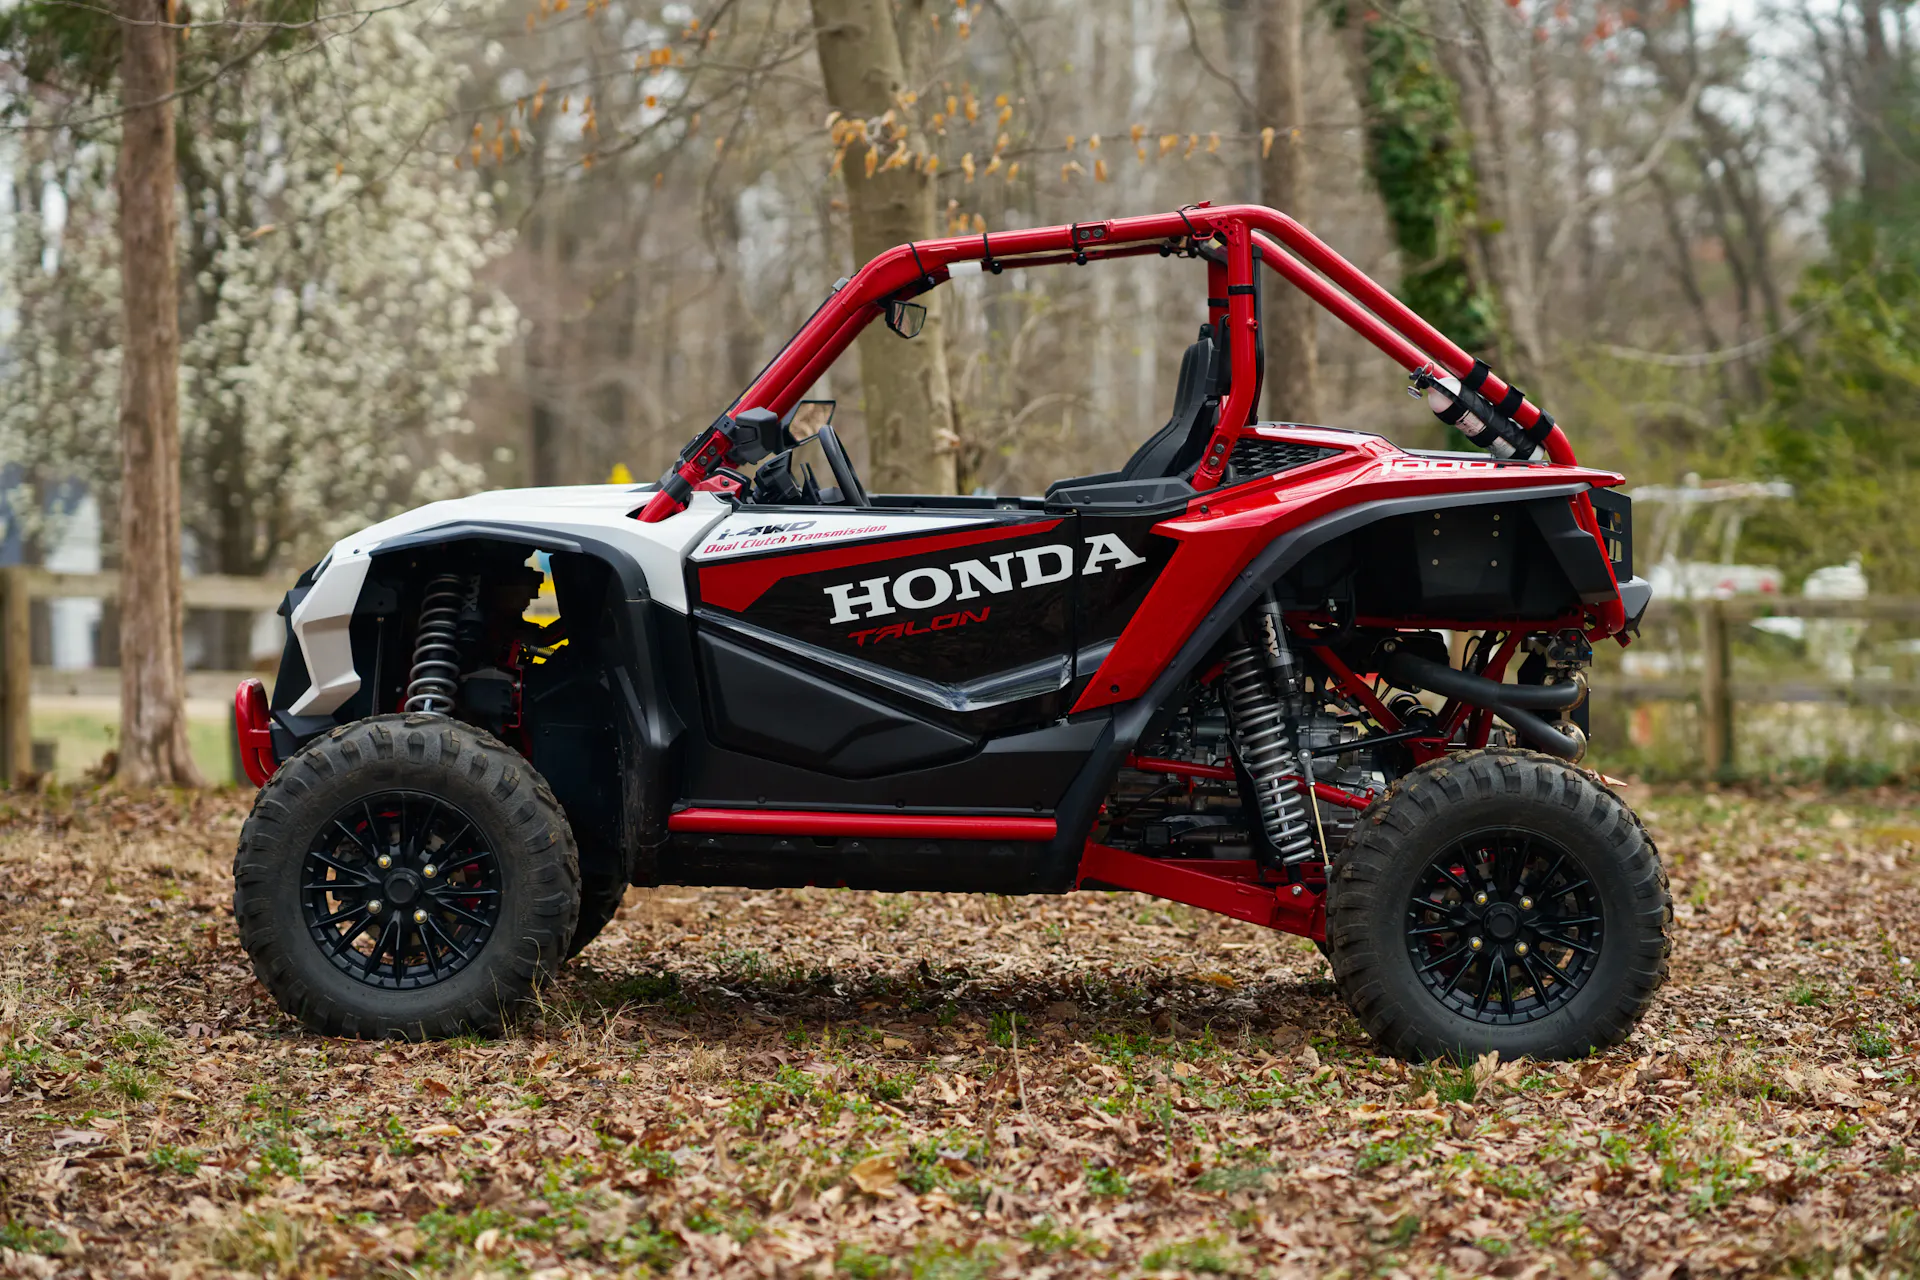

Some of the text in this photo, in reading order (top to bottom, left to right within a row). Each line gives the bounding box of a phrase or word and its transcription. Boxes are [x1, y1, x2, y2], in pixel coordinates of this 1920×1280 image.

[703, 524, 888, 554] Dual Clutch Transmission
[716, 520, 817, 540] i-4WD
[823, 532, 1147, 625] HONDA
[847, 606, 991, 647] TALON
